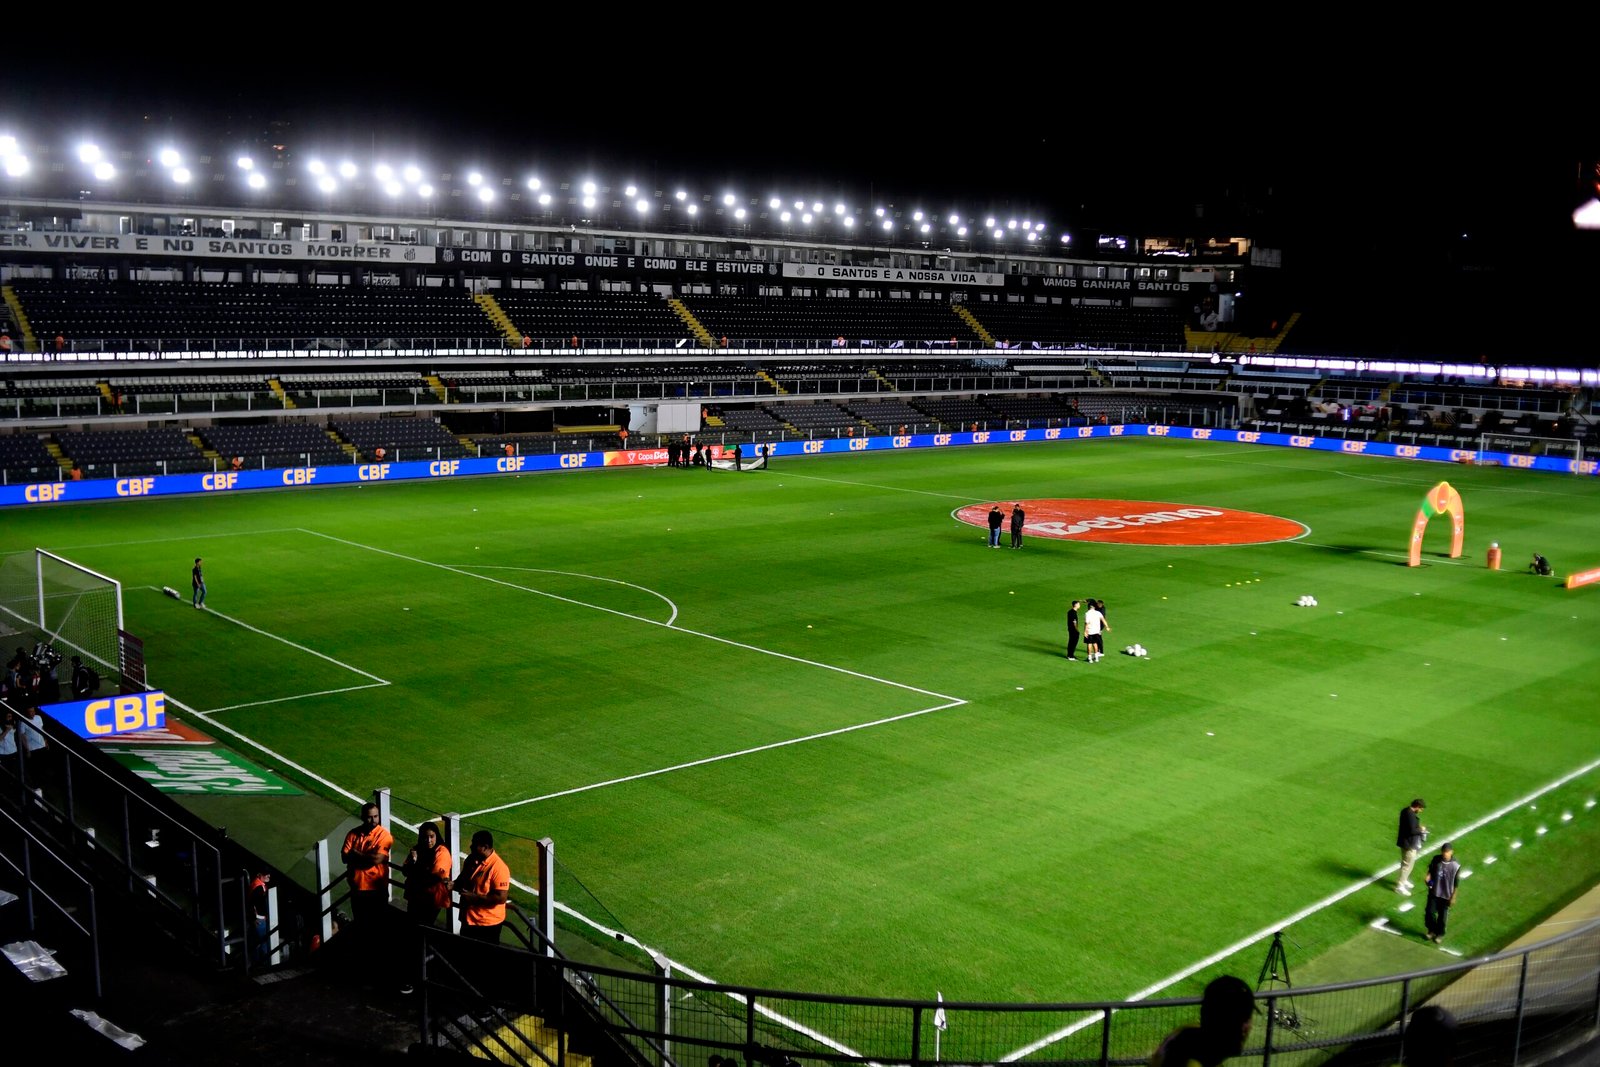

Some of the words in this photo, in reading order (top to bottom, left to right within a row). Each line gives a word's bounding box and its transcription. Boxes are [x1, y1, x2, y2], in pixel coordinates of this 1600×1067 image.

[44, 234, 119, 250] VIVER
[136, 237, 148, 250] E
[164, 238, 194, 252] NO
[209, 241, 293, 256] SANTOS
[307, 246, 391, 260] MORRER
[461, 250, 491, 263] COM
[502, 252, 511, 264] O
[521, 253, 575, 266] SANTOS
[585, 255, 618, 268] ONDE
[628, 256, 635, 268] E
[644, 258, 677, 270] COMO
[685, 259, 707, 272] ELE
[716, 261, 764, 274] ESTIVER
[818, 267, 825, 276] O
[832, 268, 878, 279] SANTOS
[896, 270, 904, 279] A
[909, 271, 945, 281] NOSSA
[951, 273, 976, 283] VIDA
[1043, 277, 1077, 288] VAMOS
[1082, 279, 1131, 290] GANHAR
[1138, 281, 1190, 291] SANTOS
[973, 431, 991, 443] CBF
[1010, 429, 1027, 441] CBF
[1045, 428, 1061, 439] CBF
[1079, 426, 1094, 437] CBF
[1110, 425, 1124, 436] CBF
[1148, 425, 1170, 437] CBF
[1192, 428, 1212, 440] CBF
[1237, 431, 1261, 443] CBF
[803, 440, 824, 453] CBF
[849, 438, 869, 451] CBF
[893, 435, 912, 448] CBF
[934, 433, 952, 446] CBF
[1290, 435, 1314, 448] CBF
[1343, 440, 1367, 453] CBF
[755, 443, 777, 457] CF
[1396, 445, 1421, 459] CBF
[497, 456, 525, 472] CBF
[560, 453, 587, 468] CBF
[1509, 455, 1536, 468] CBF
[359, 464, 390, 481] CBF
[430, 460, 460, 476] CBF
[202, 473, 238, 491] CBF
[283, 468, 316, 485] CBF
[25, 483, 65, 502] CBF
[116, 478, 155, 496] CBF
[1023, 508, 1224, 535] Betano
[84, 693, 166, 735] CBF
